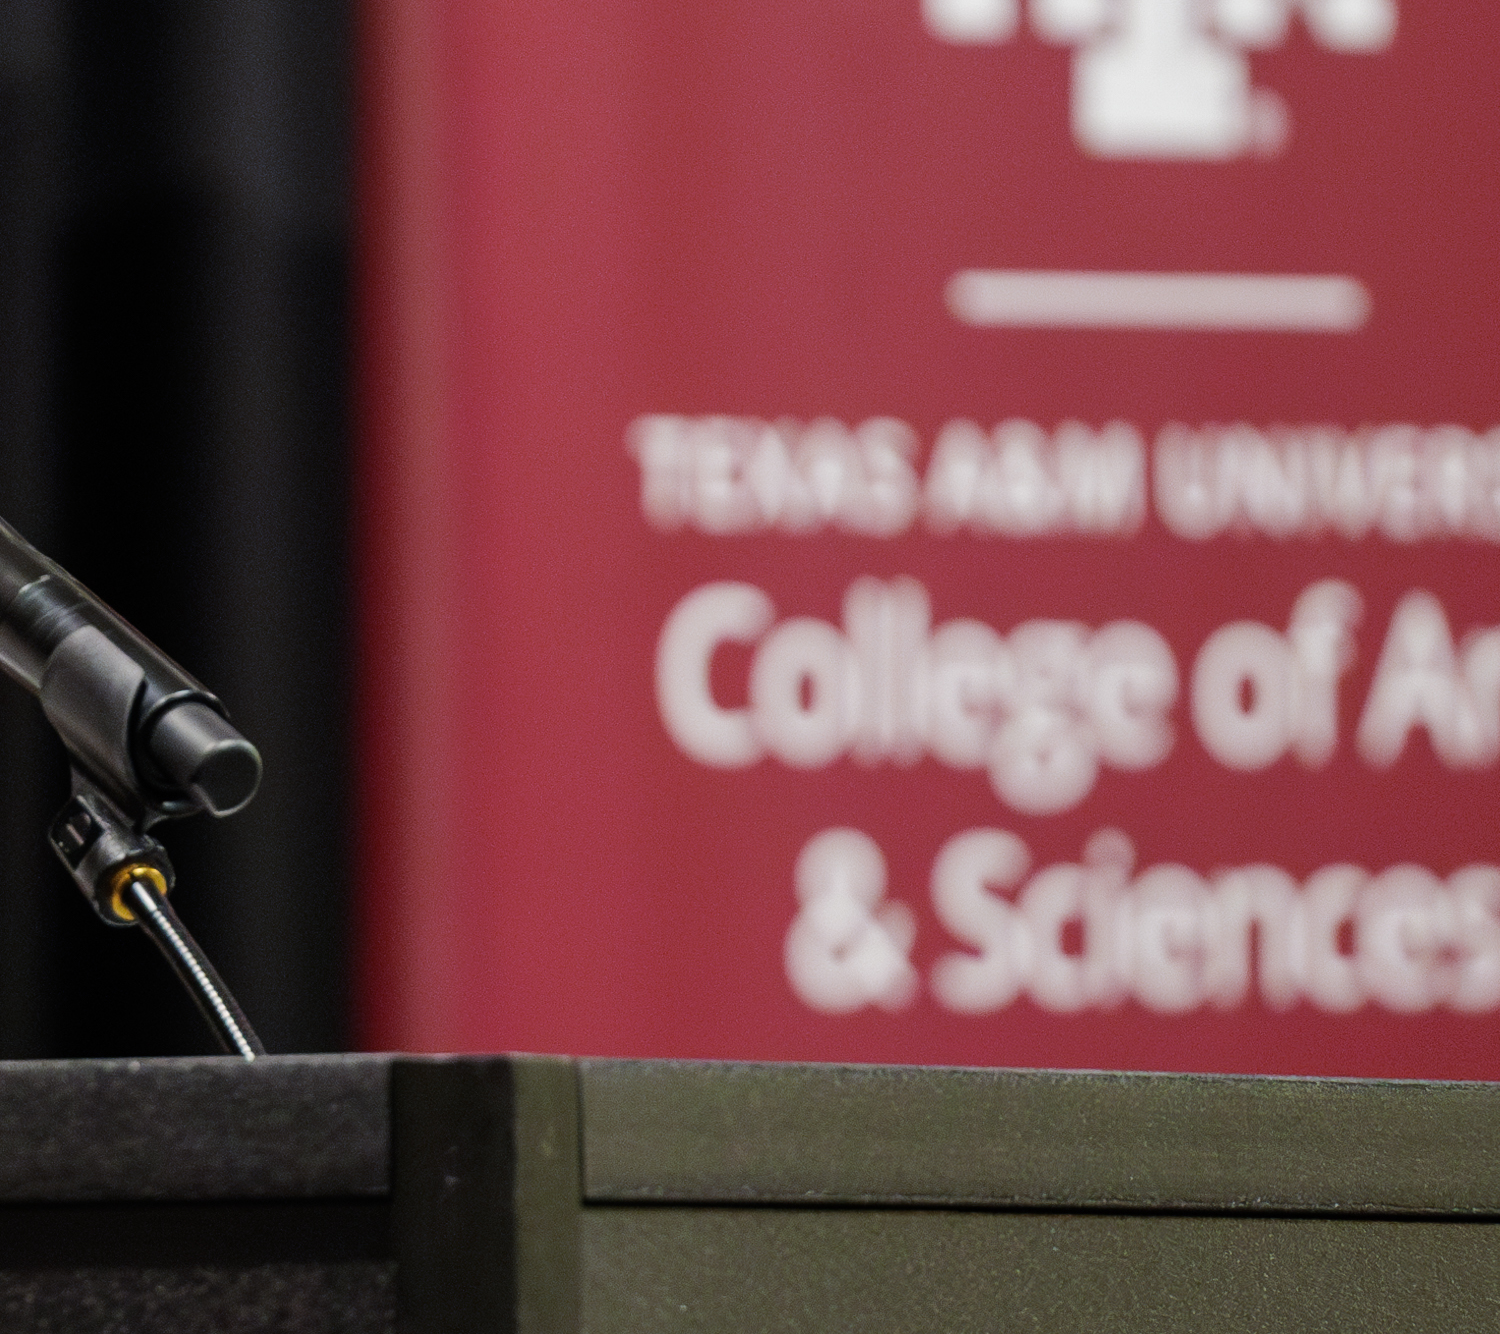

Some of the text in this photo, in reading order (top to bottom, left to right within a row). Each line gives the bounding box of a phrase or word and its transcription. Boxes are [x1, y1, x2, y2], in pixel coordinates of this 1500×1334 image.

[627, 417, 917, 537] TEXAS
[925, 419, 1147, 539] A&M
[655, 577, 1180, 814] College
[1191, 579, 1363, 770] of
[785, 828, 918, 1014] &
